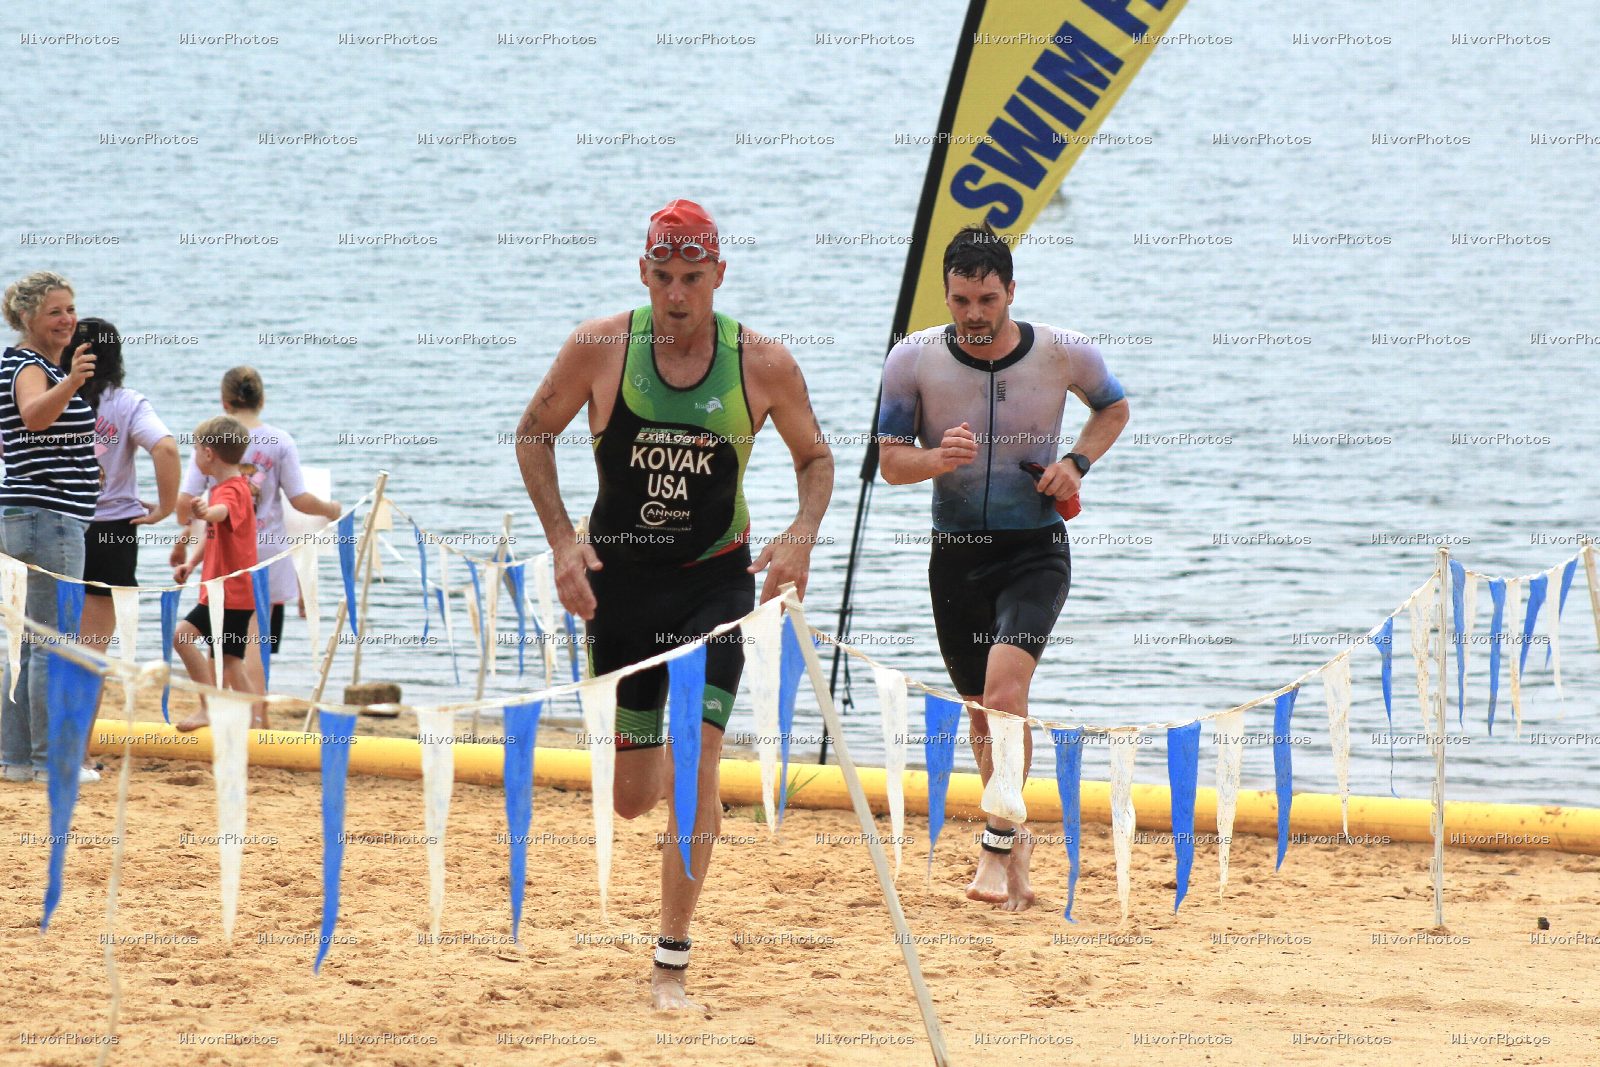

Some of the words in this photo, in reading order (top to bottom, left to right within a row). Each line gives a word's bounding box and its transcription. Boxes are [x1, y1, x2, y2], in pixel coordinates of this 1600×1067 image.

[950, 20, 1125, 229] SWIM
[629, 445, 715, 475] KOVAK
[647, 473, 688, 501] USA
[640, 500, 691, 526] CANNON
